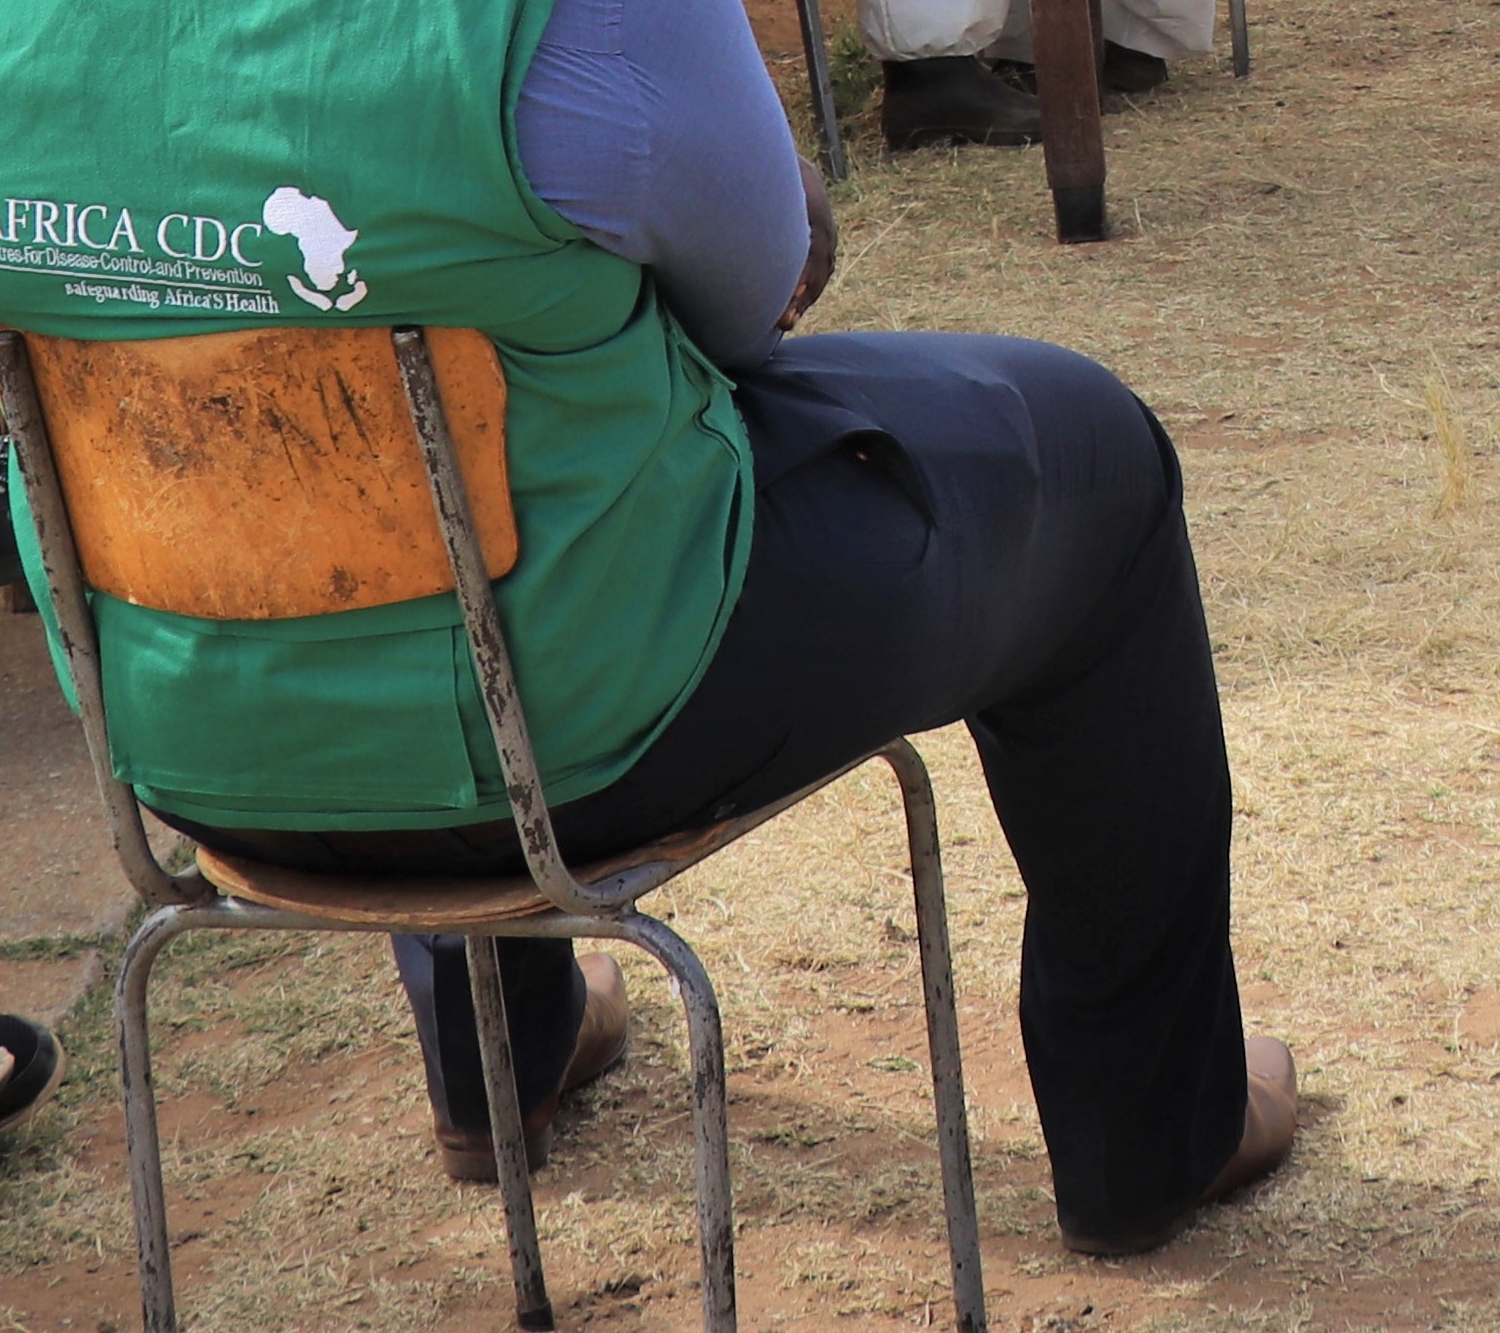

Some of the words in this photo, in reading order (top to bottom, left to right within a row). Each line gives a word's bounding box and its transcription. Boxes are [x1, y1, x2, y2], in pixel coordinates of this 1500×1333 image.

[157, 213, 265, 267] CDC
[23, 245, 45, 265] For
[45, 247, 99, 269] Disease
[100, 251, 151, 274] Control
[154, 259, 183, 279] and
[184, 261, 264, 287] Prevention
[65, 280, 161, 310] safeguarding
[225, 293, 280, 314] Health
